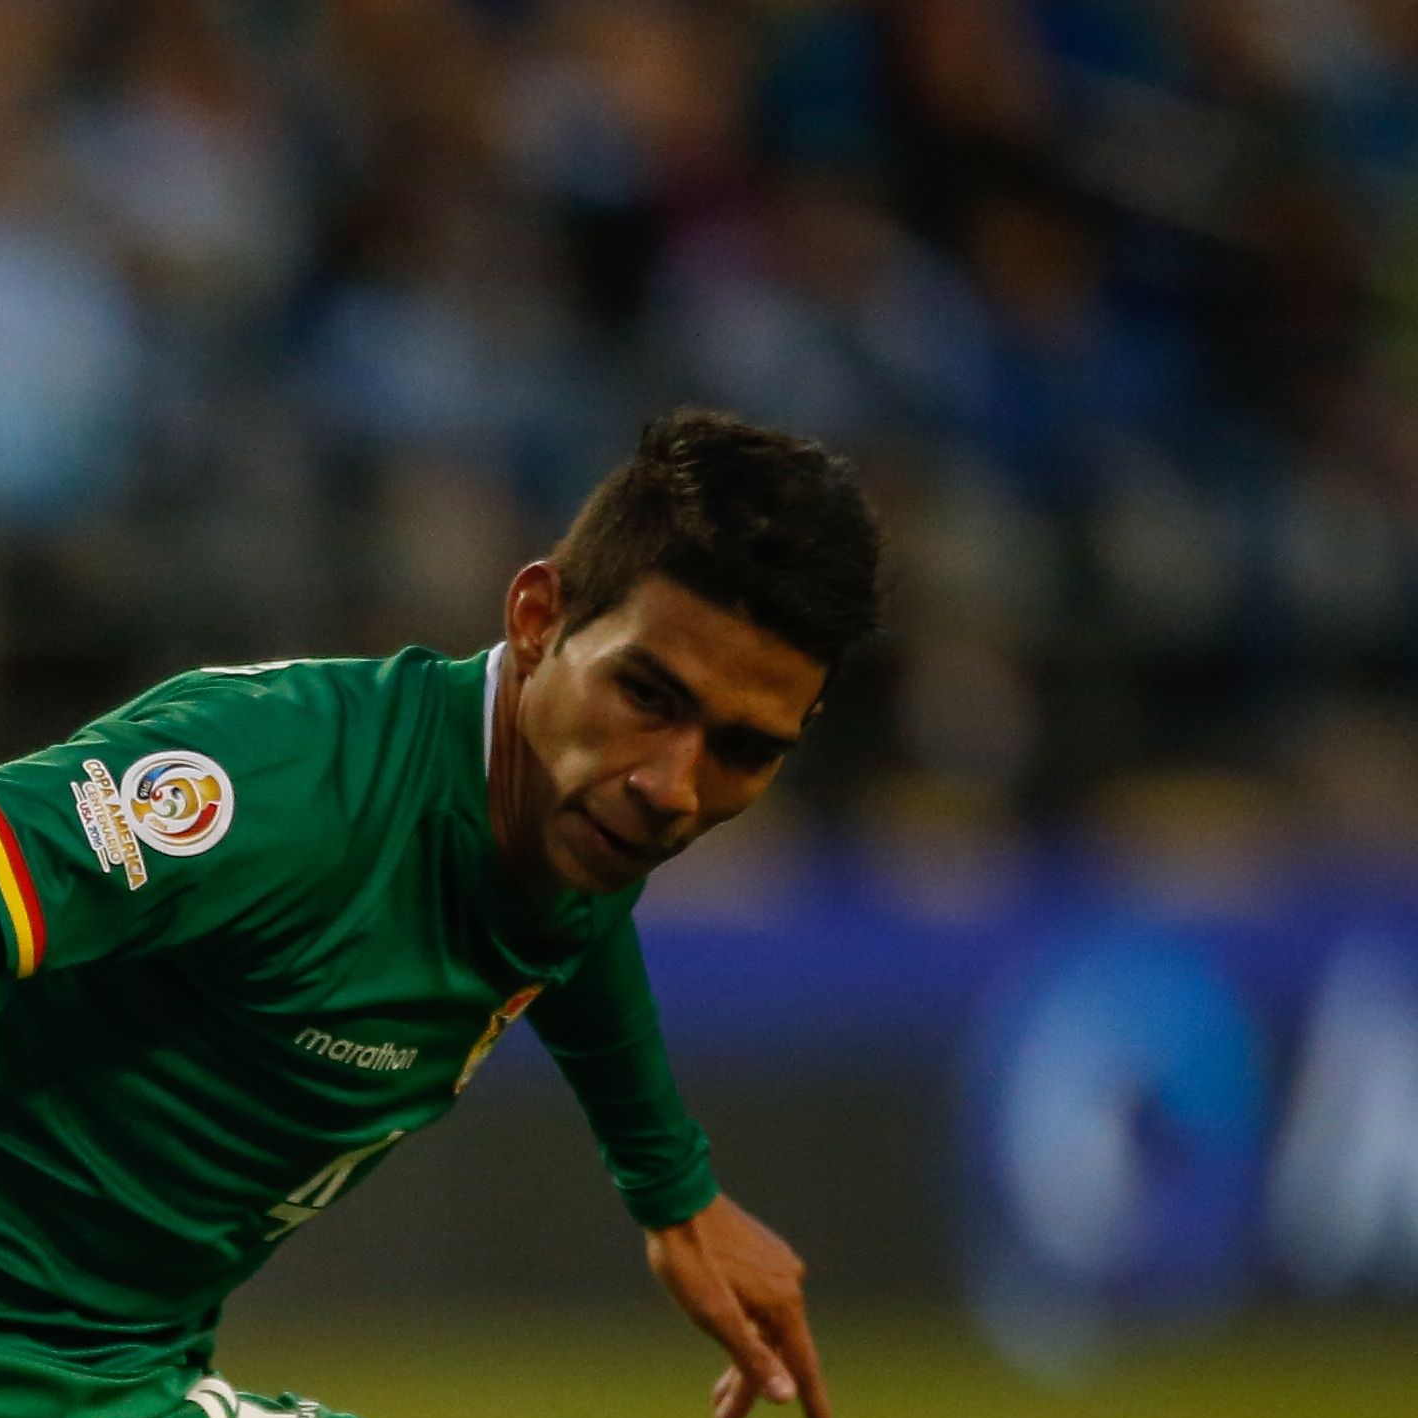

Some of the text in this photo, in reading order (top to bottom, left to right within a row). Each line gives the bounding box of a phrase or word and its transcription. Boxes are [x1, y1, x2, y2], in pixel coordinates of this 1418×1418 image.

[78, 802, 104, 849] USA 2016
[84, 783, 121, 861] CENTENARIO
[85, 761, 147, 888] COPA AMERICA
